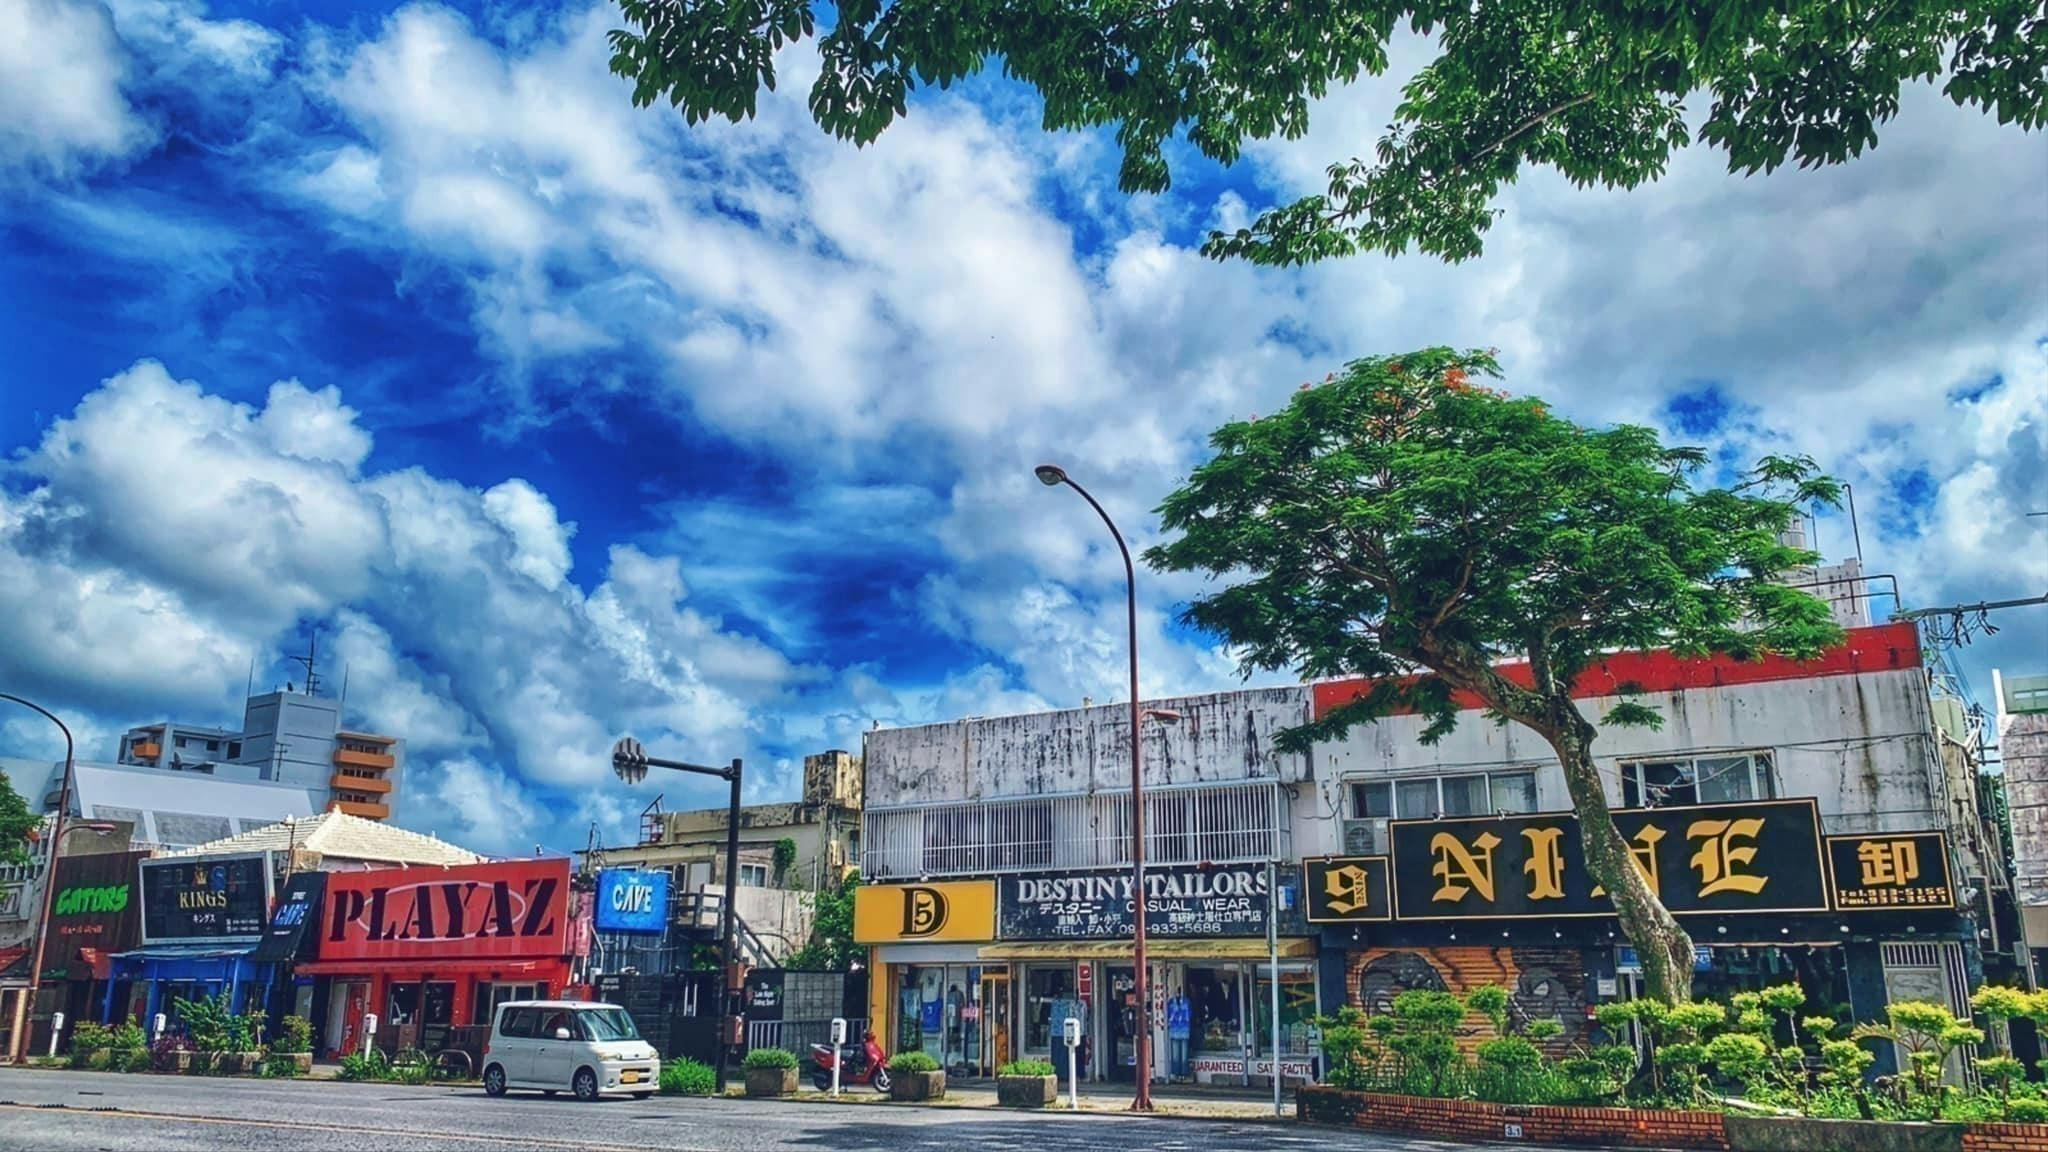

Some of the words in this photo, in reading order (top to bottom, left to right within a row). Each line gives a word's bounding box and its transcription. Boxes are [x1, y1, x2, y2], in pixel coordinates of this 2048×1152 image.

[1857, 841, 1919, 885] 卸
[56, 884, 129, 916] GATORS
[179, 889, 227, 909] KINGS
[612, 884, 653, 913] CAVE
[1018, 876, 1135, 902] DESTINY
[1144, 871, 1268, 900] TAILORS
[1324, 864, 1368, 914] 9
[193, 913, 216, 924] キングス
[329, 878, 558, 942] PLAYAZ
[1040, 902, 1102, 914] デスタニー
[1125, 898, 1193, 913] CSUAL
[1202, 898, 1251, 911] WEAR
[1120, 922, 1222, 935] 09-933-5686
